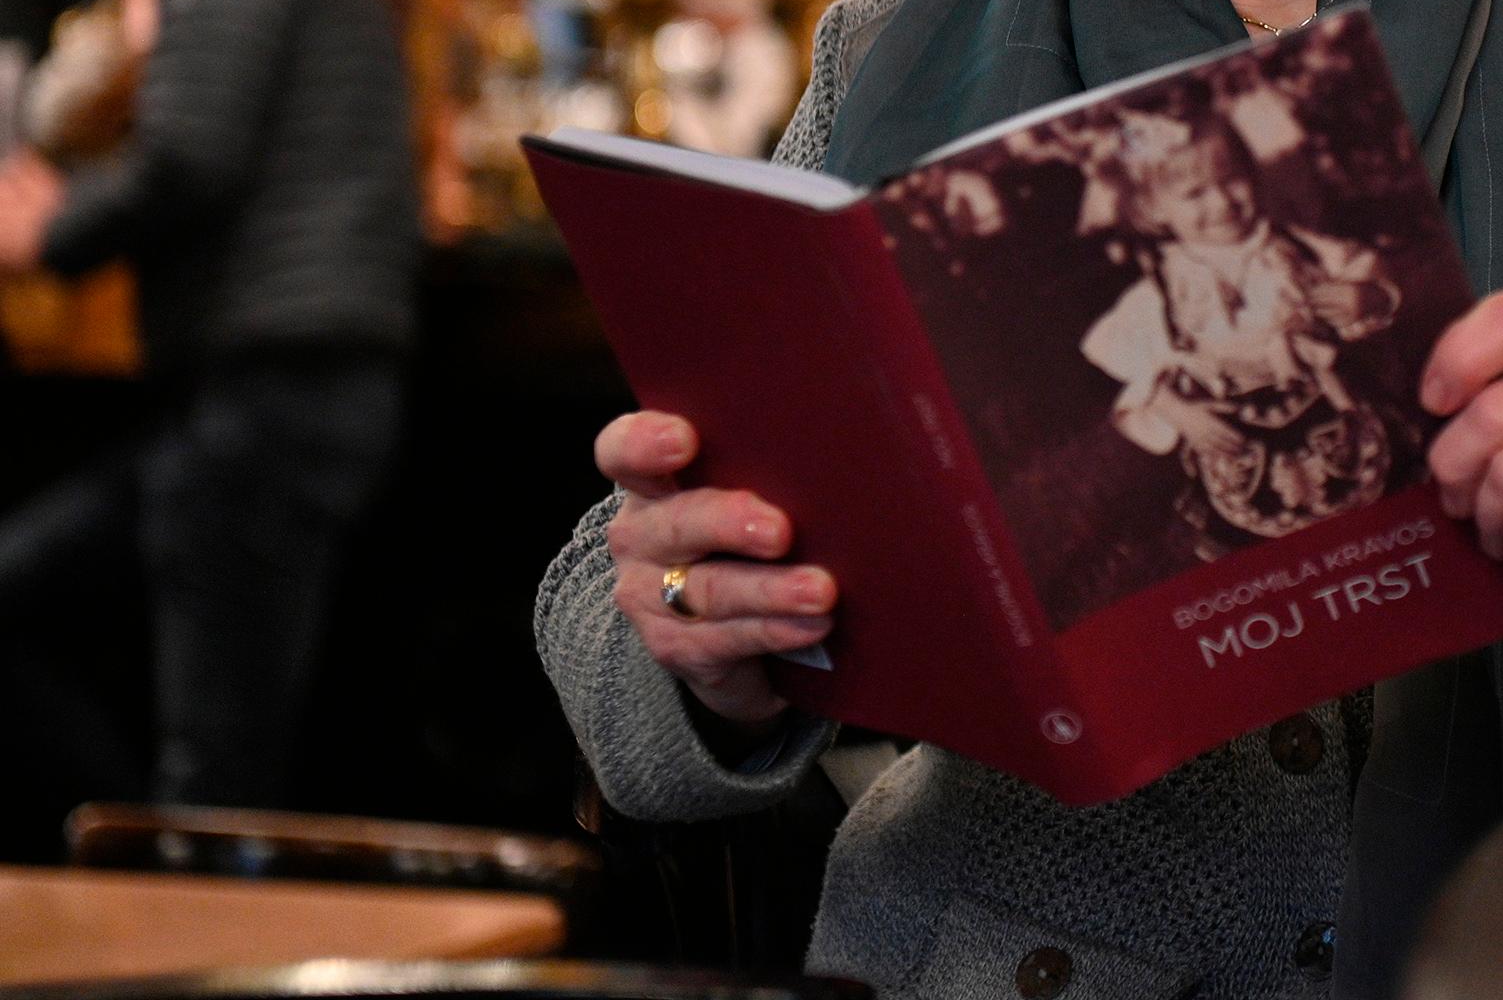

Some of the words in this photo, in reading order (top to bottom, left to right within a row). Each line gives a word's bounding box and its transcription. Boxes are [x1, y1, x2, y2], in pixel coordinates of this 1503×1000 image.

[1173, 561, 1319, 630] BOGOMILA
[1325, 520, 1436, 572] KRAVOS
[1197, 601, 1304, 669] MOJ
[1312, 552, 1432, 621] TRST
